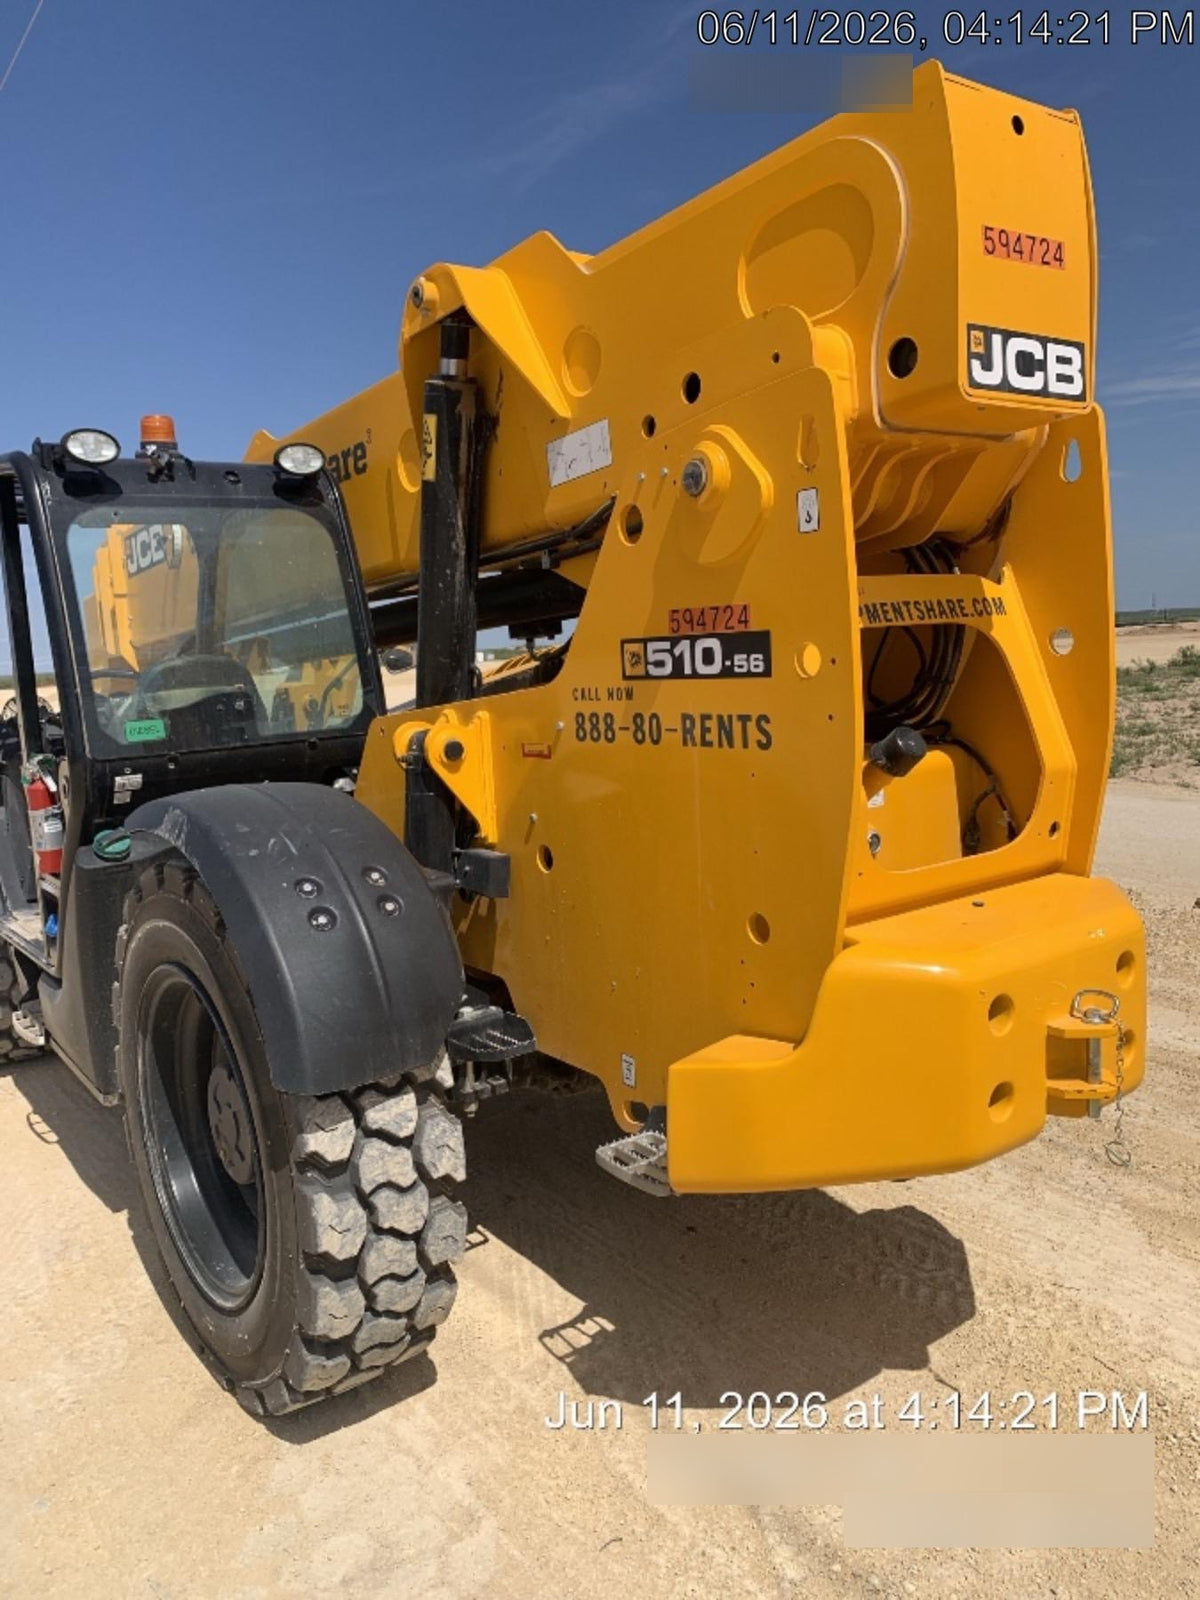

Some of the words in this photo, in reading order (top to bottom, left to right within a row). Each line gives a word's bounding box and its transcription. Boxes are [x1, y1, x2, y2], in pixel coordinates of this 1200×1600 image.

[984, 226, 1064, 267] 594724
[971, 333, 1083, 396] JCB
[671, 604, 751, 634] 594724
[572, 688, 602, 701] CALL
[607, 686, 634, 701] NOW
[575, 711, 773, 751] 888-80-RENTS
